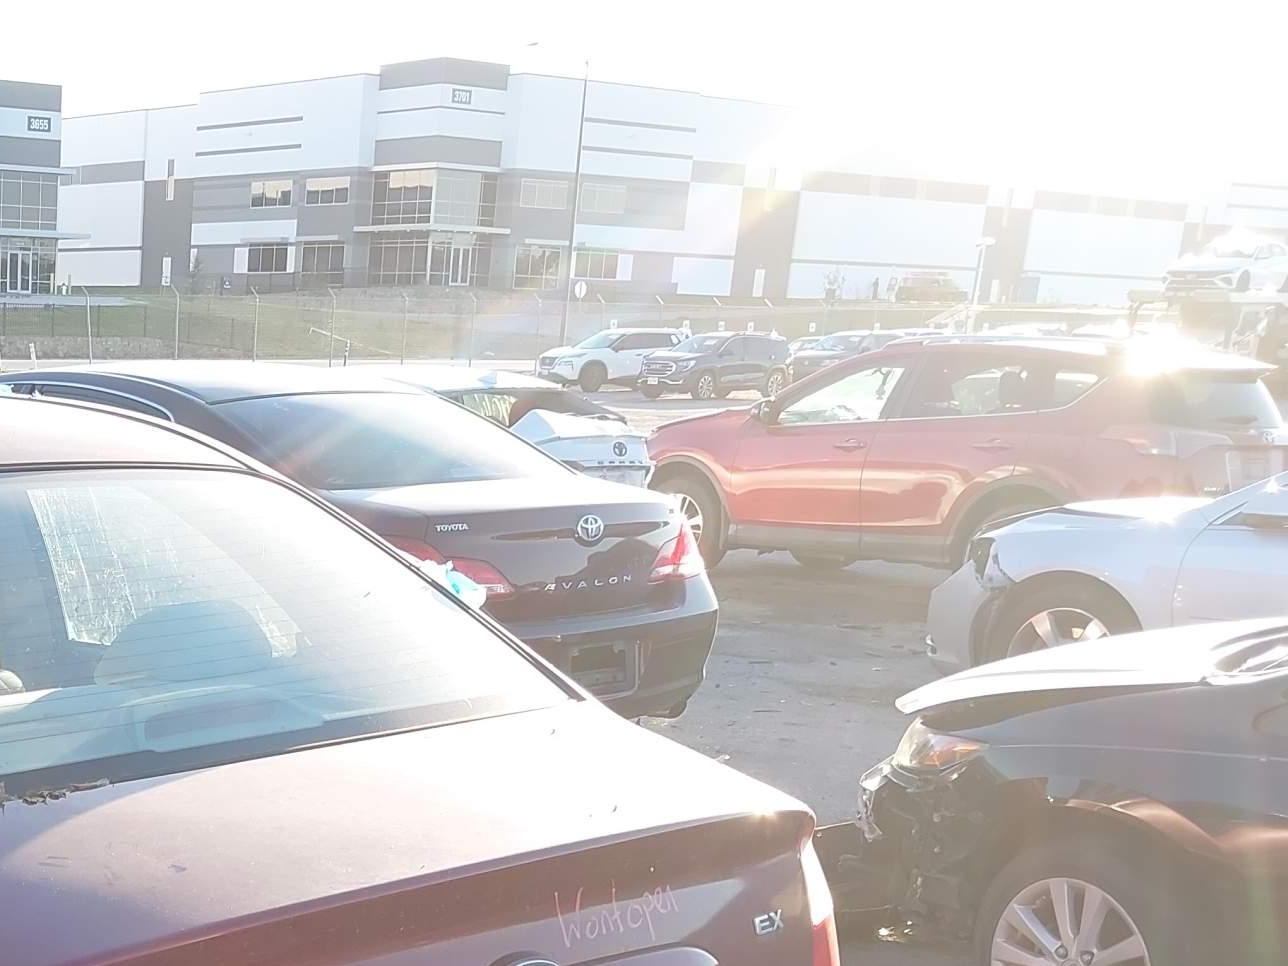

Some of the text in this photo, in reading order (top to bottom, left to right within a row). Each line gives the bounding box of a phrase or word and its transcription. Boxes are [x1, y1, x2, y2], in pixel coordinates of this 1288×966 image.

[30, 118, 49, 131] 3655
[435, 523, 469, 532] TOYOTA
[544, 575, 632, 592] AVALON
[754, 908, 785, 936] EX
